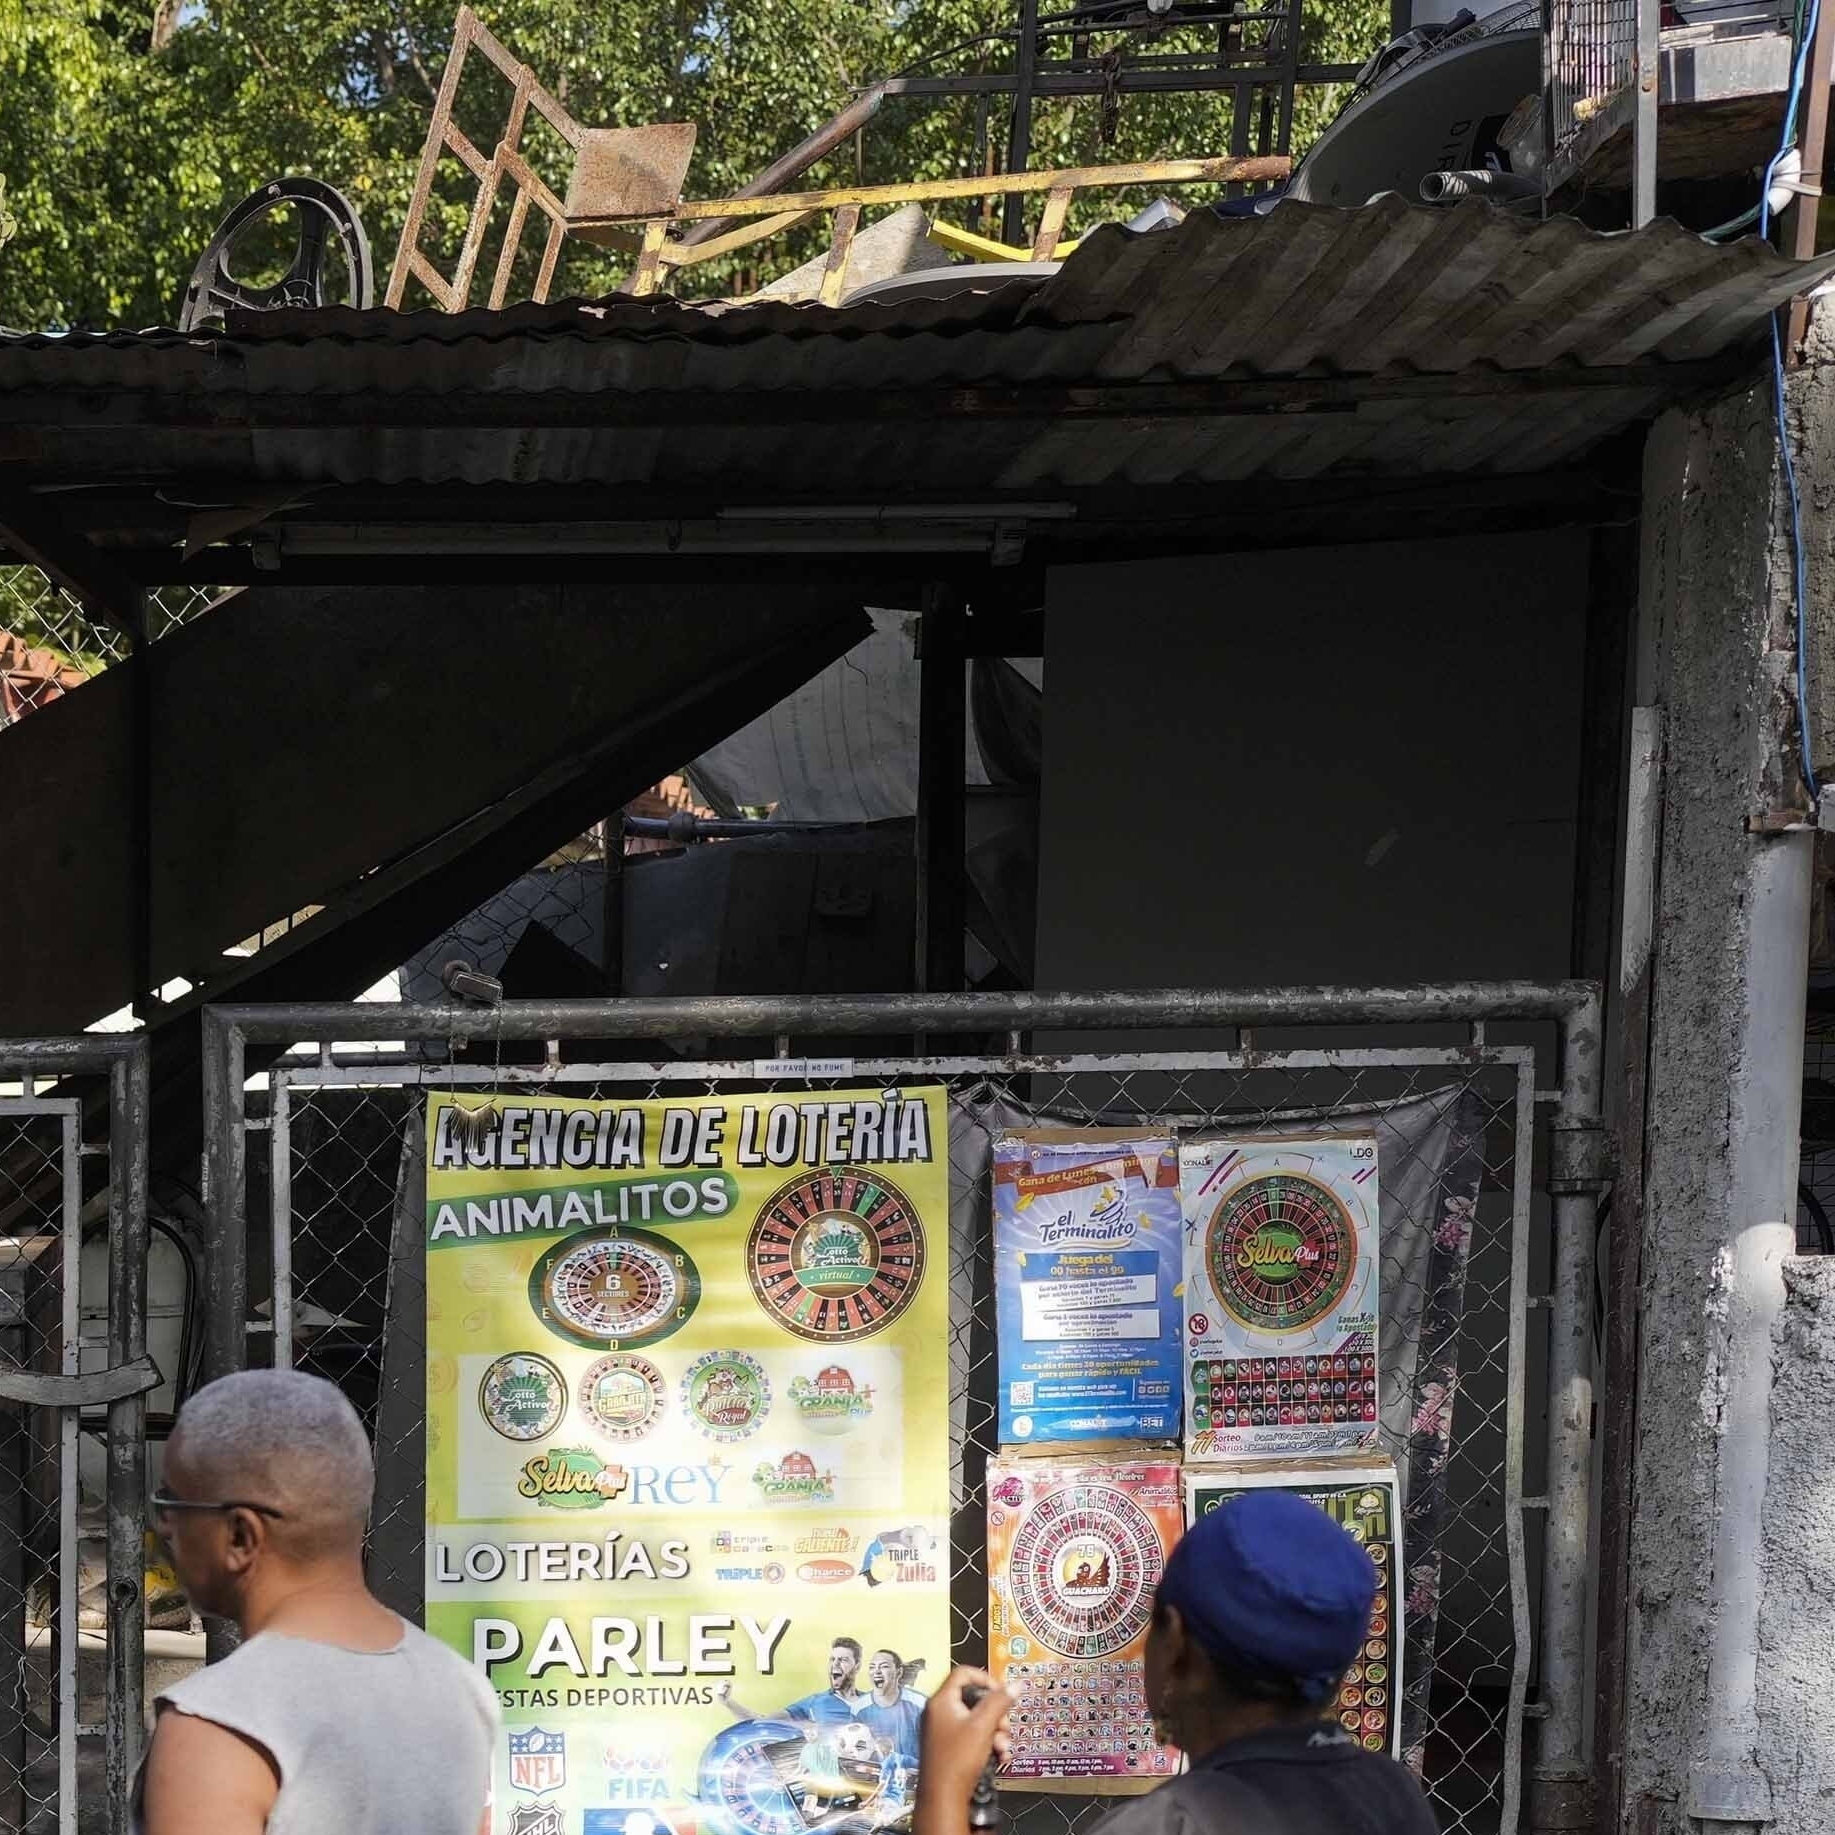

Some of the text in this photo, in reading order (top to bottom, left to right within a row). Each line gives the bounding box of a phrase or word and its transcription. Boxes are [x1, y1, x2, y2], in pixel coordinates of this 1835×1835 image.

[432, 1086, 932, 1168] AGENCIA DE LOTERÍA
[1018, 1176, 1045, 1187] Gana
[431, 1176, 729, 1241] ANIMALITOS
[1057, 1210, 1073, 1227] el
[1039, 1221, 1135, 1243] Terminalito
[1057, 1254, 1095, 1267] Juega
[1237, 1233, 1320, 1268] Selva Plus
[605, 1274, 622, 1290] 6
[818, 1270, 854, 1281] virtual
[1213, 1433, 1242, 1443] Sorteo
[1213, 1443, 1244, 1453] Diarios
[518, 1456, 597, 1498] Selva
[436, 1530, 690, 1583] LOTERÍAS
[887, 1548, 920, 1562] TRIPLE
[895, 1562, 937, 1583] Zulia
[1062, 1585, 1111, 1597] GUACHARO
[472, 1614, 791, 1680] PARLEY
[566, 1686, 714, 1707] DEPORTIVAS
[514, 1756, 561, 1788] NFL
[607, 1777, 671, 1800] FIFA
